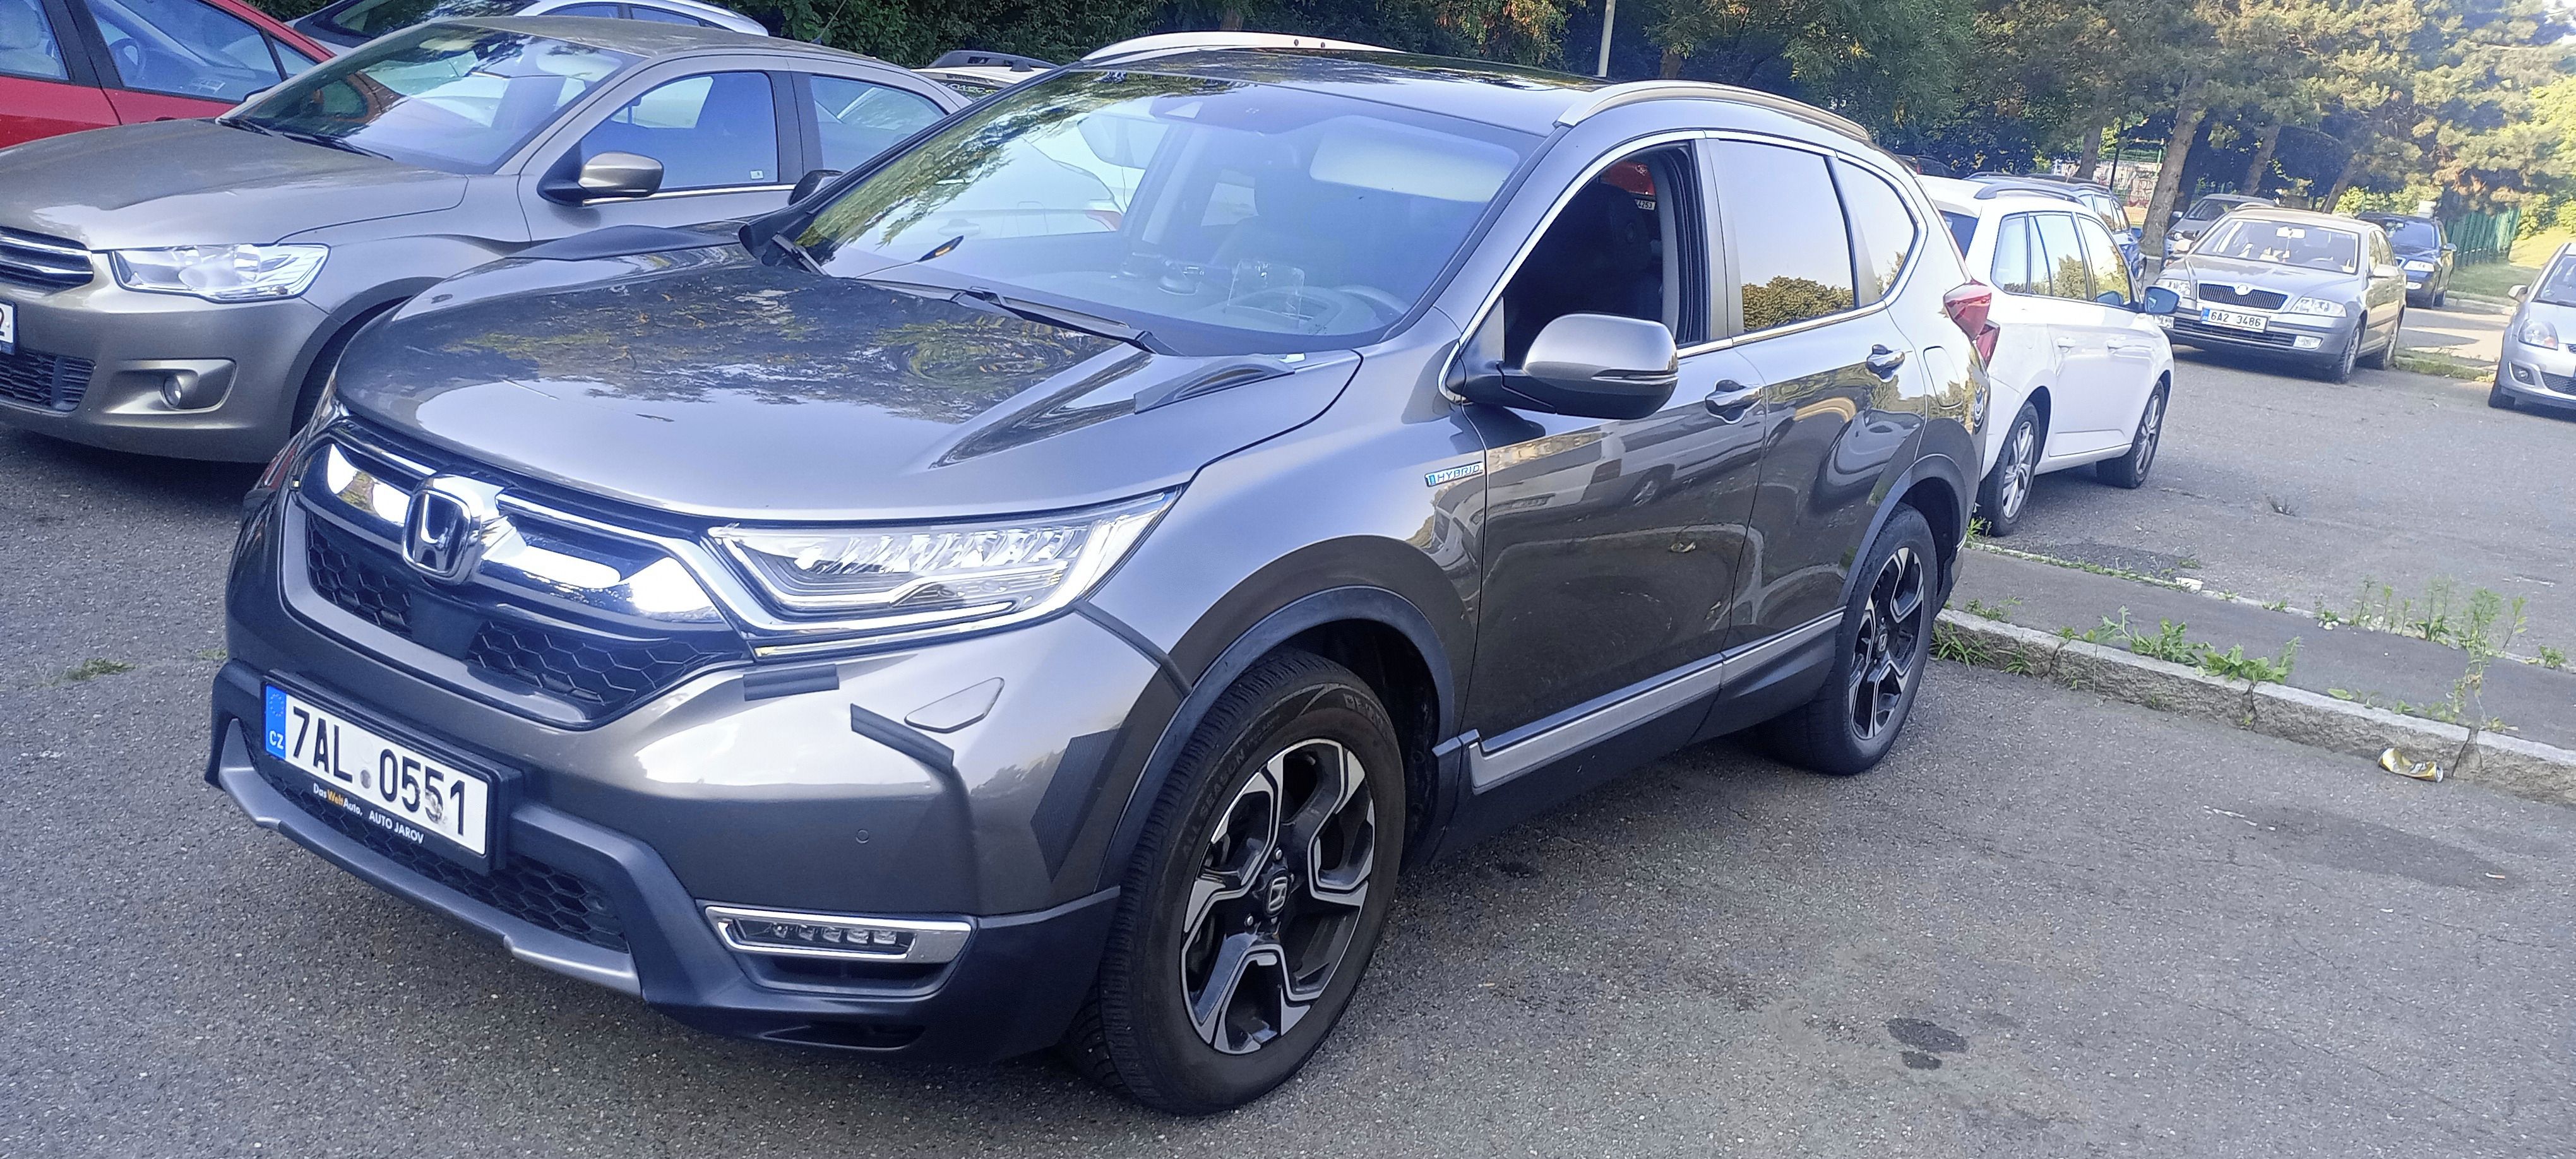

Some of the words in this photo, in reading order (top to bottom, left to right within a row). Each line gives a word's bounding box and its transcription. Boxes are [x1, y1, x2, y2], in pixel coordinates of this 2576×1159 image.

[2210, 311, 2229, 323] 6A2
[2236, 315, 2262, 327] 3486
[1437, 465, 1480, 482] HYBRID
[268, 730, 284, 750] CZ
[292, 705, 353, 783] 7AL
[379, 748, 466, 837] 0551
[369, 810, 393, 830] AUTO
[394, 822, 424, 845] JAROV
